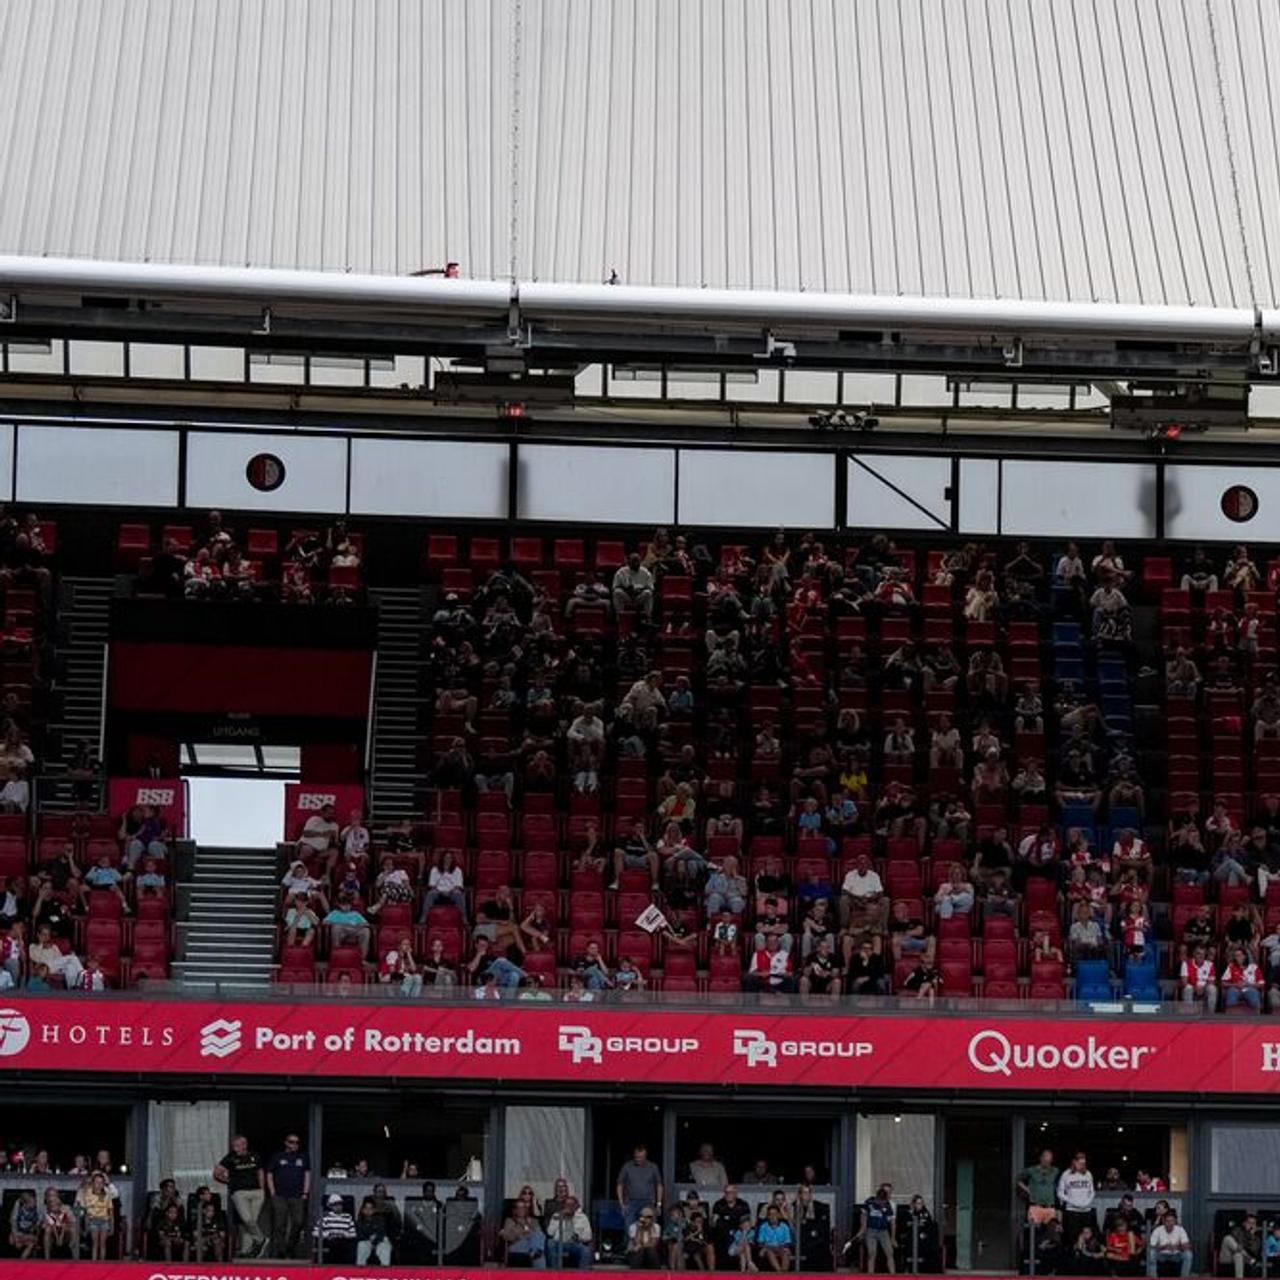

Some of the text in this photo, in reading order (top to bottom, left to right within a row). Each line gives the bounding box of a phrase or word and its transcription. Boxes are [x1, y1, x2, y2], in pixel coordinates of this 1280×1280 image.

[41, 1024, 174, 1046] HOTELS
[255, 1026, 521, 1055] Port of Rotterdam
[606, 1037, 699, 1053] GROUP
[780, 1041, 874, 1057] GROUP
[967, 1030, 1149, 1076] Quooker
